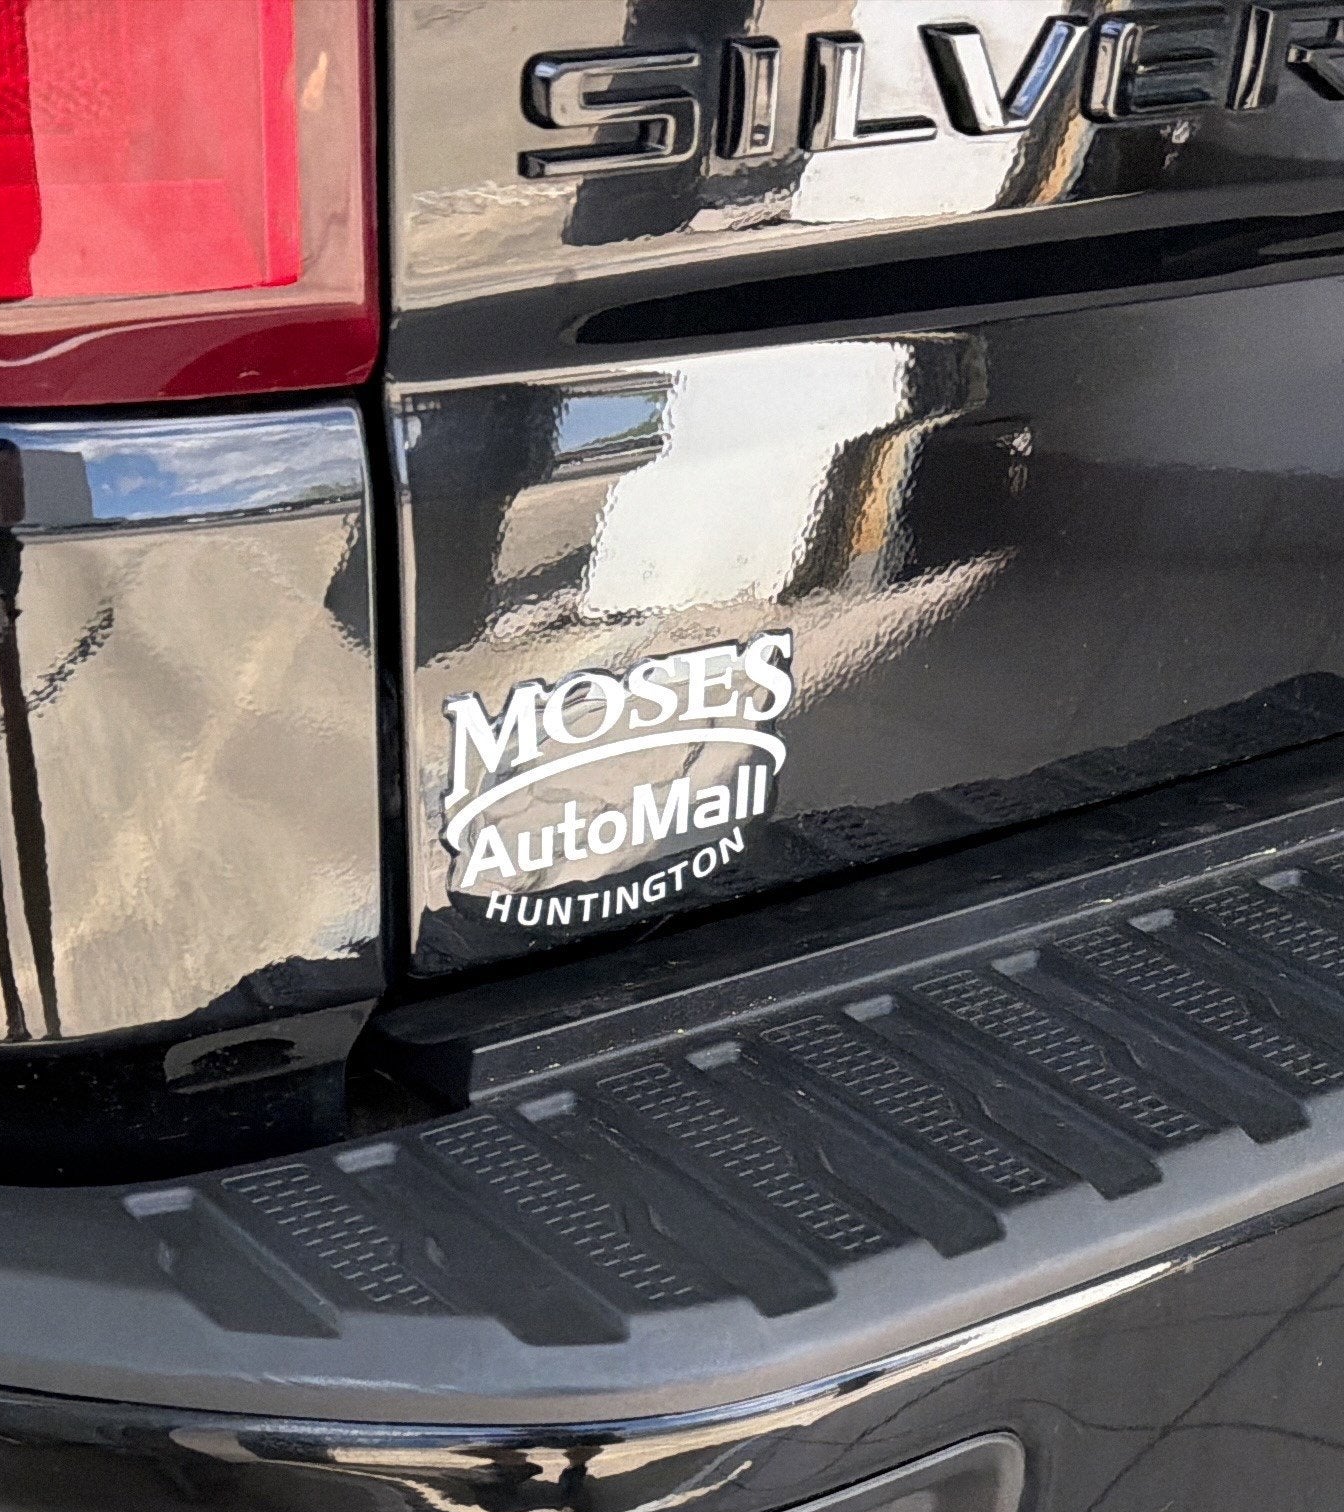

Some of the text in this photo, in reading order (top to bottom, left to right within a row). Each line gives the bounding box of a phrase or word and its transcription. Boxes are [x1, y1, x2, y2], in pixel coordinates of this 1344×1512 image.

[444, 633, 792, 810] MOSES
[460, 764, 767, 889] AutoMall
[485, 826, 745, 926] HUNTINGTON
